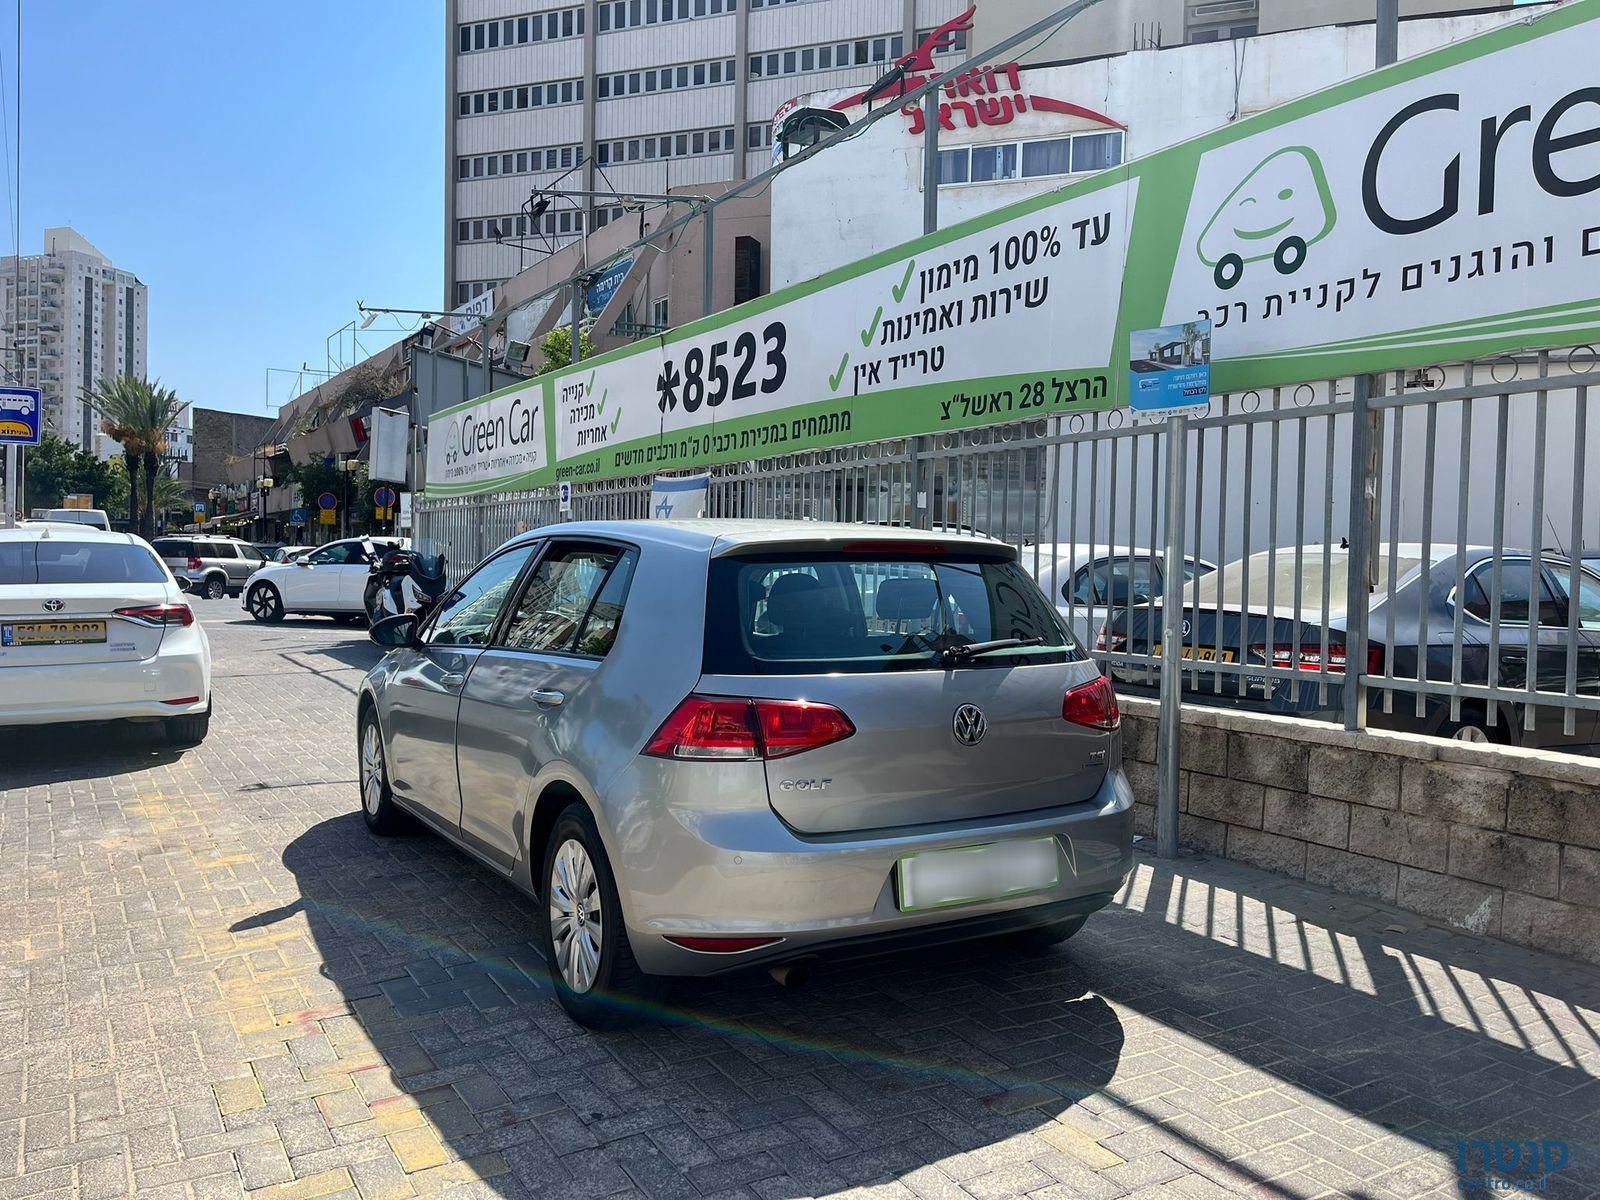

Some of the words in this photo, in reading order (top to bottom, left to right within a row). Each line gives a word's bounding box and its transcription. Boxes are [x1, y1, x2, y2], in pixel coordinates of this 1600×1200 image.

[1072, 212, 1111, 250] עד
[989, 225, 1061, 275] 100%
[1401, 236, 1554, 292] והוגנים
[920, 254, 979, 304] מימון
[1263, 267, 1381, 320] לקניית
[970, 276, 1049, 323] שירות
[881, 300, 963, 346] ואמינות
[888, 345, 945, 381] טרייד
[562, 382, 584, 403] קנייה
[853, 360, 882, 396] אין
[1052, 375, 1107, 404] הרצל
[1020, 381, 1045, 410] 28
[462, 414, 505, 457] Green
[509, 399, 539, 446] Car
[570, 403, 595, 424] מכירה
[792, 410, 851, 440] מתמחים
[577, 425, 607, 446] אחריות
[713, 432, 737, 453] רכבי
[740, 422, 788, 448] במכירת
[615, 448, 644, 467] חדשים
[647, 441, 677, 462] ורכבים
[555, 458, 600, 481] green-car.co.il
[779, 778, 833, 791] GOLF
